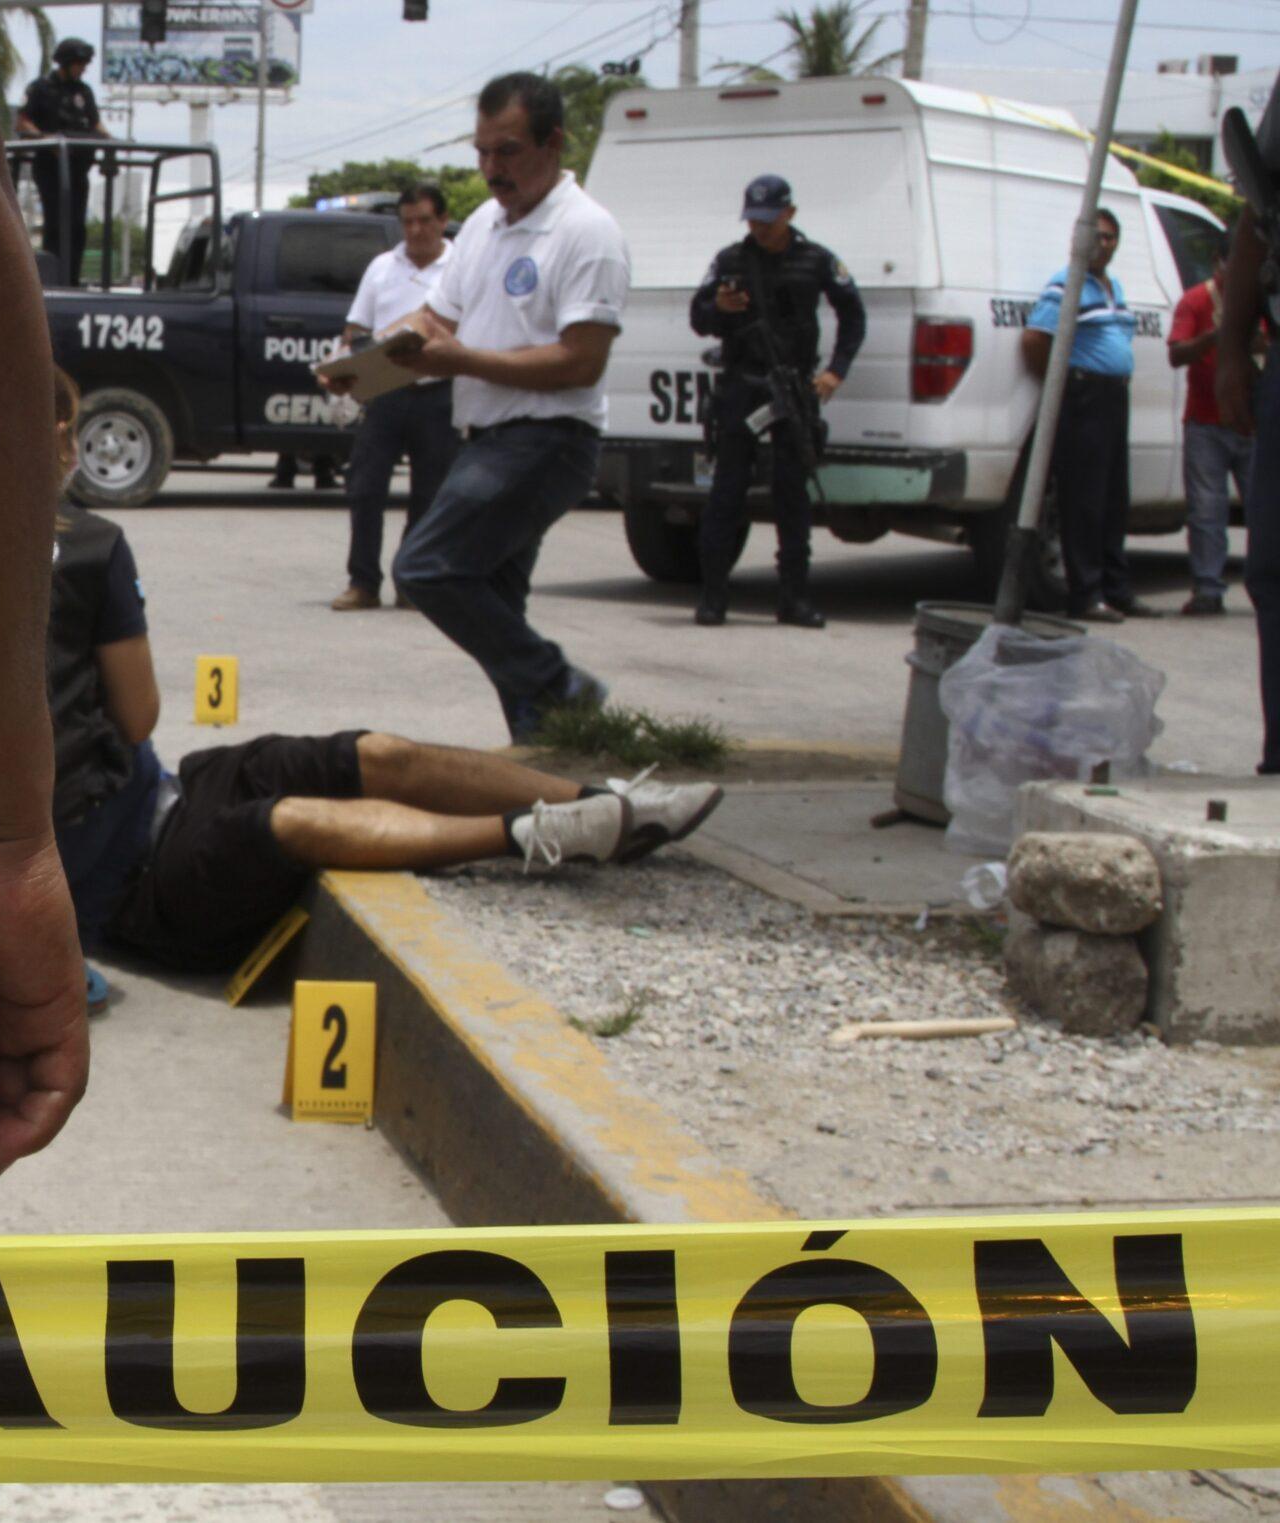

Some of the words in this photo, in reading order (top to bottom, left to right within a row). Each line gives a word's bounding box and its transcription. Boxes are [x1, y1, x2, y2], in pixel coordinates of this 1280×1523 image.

[78, 314, 164, 350] 17342
[265, 337, 334, 362] POLIC
[208, 667, 223, 709] 3
[321, 1004, 348, 1089] 2
